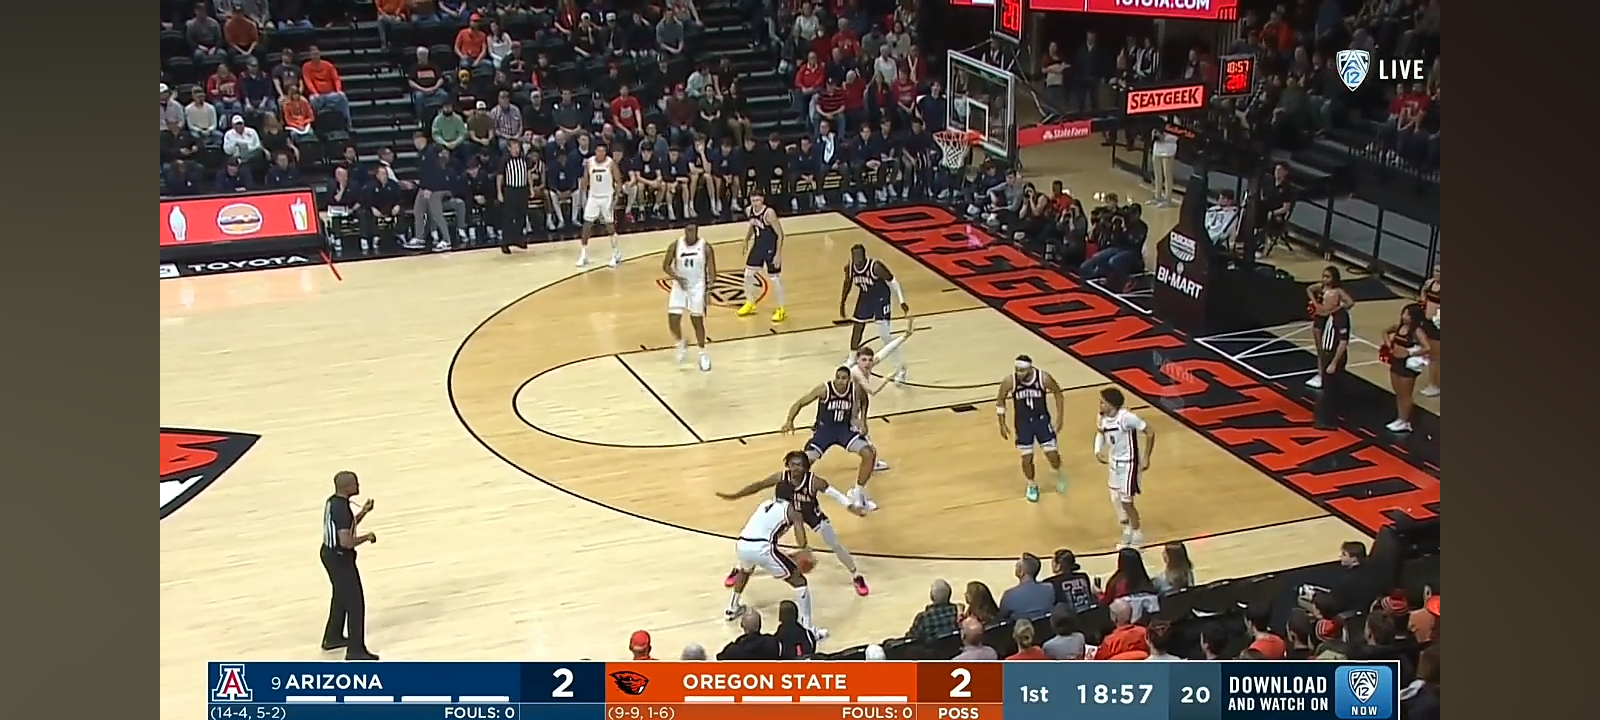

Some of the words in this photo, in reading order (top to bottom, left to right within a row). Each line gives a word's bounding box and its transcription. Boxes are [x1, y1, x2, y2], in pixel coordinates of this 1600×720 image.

[1130, 87, 1200, 110] SEATGEEK
[188, 255, 308, 273] TOYOTA
[853, 203, 1188, 358] OREGON
[1110, 358, 1440, 534] STATE
